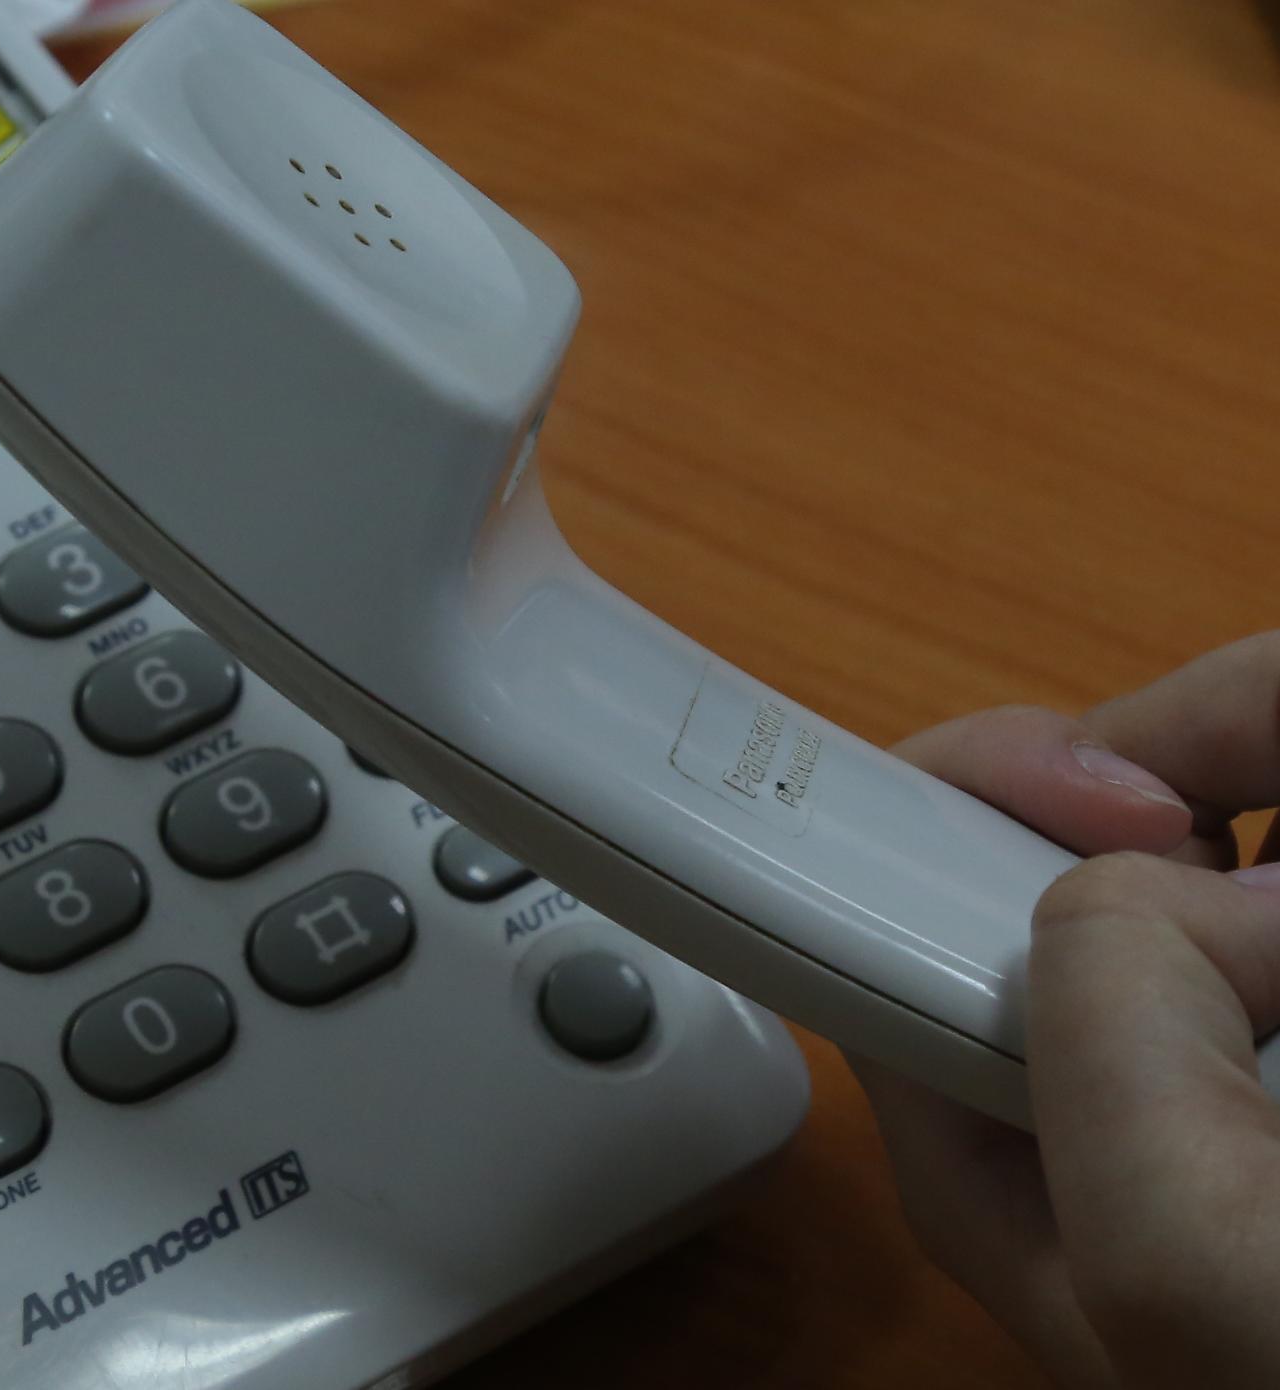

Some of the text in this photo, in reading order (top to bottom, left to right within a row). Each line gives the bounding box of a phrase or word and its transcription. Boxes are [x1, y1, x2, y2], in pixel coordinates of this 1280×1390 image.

[7, 504, 56, 539] DEF
[47, 544, 104, 597] 3
[86, 617, 150, 659] MNO
[134, 656, 188, 710] 6
[165, 728, 243, 777] WXYZ
[216, 775, 273, 832] 9
[34, 868, 93, 928] 8
[504, 889, 578, 944] AUTO
[121, 995, 179, 1056] 0
[20, 1156, 307, 1346] Advanced ITS
